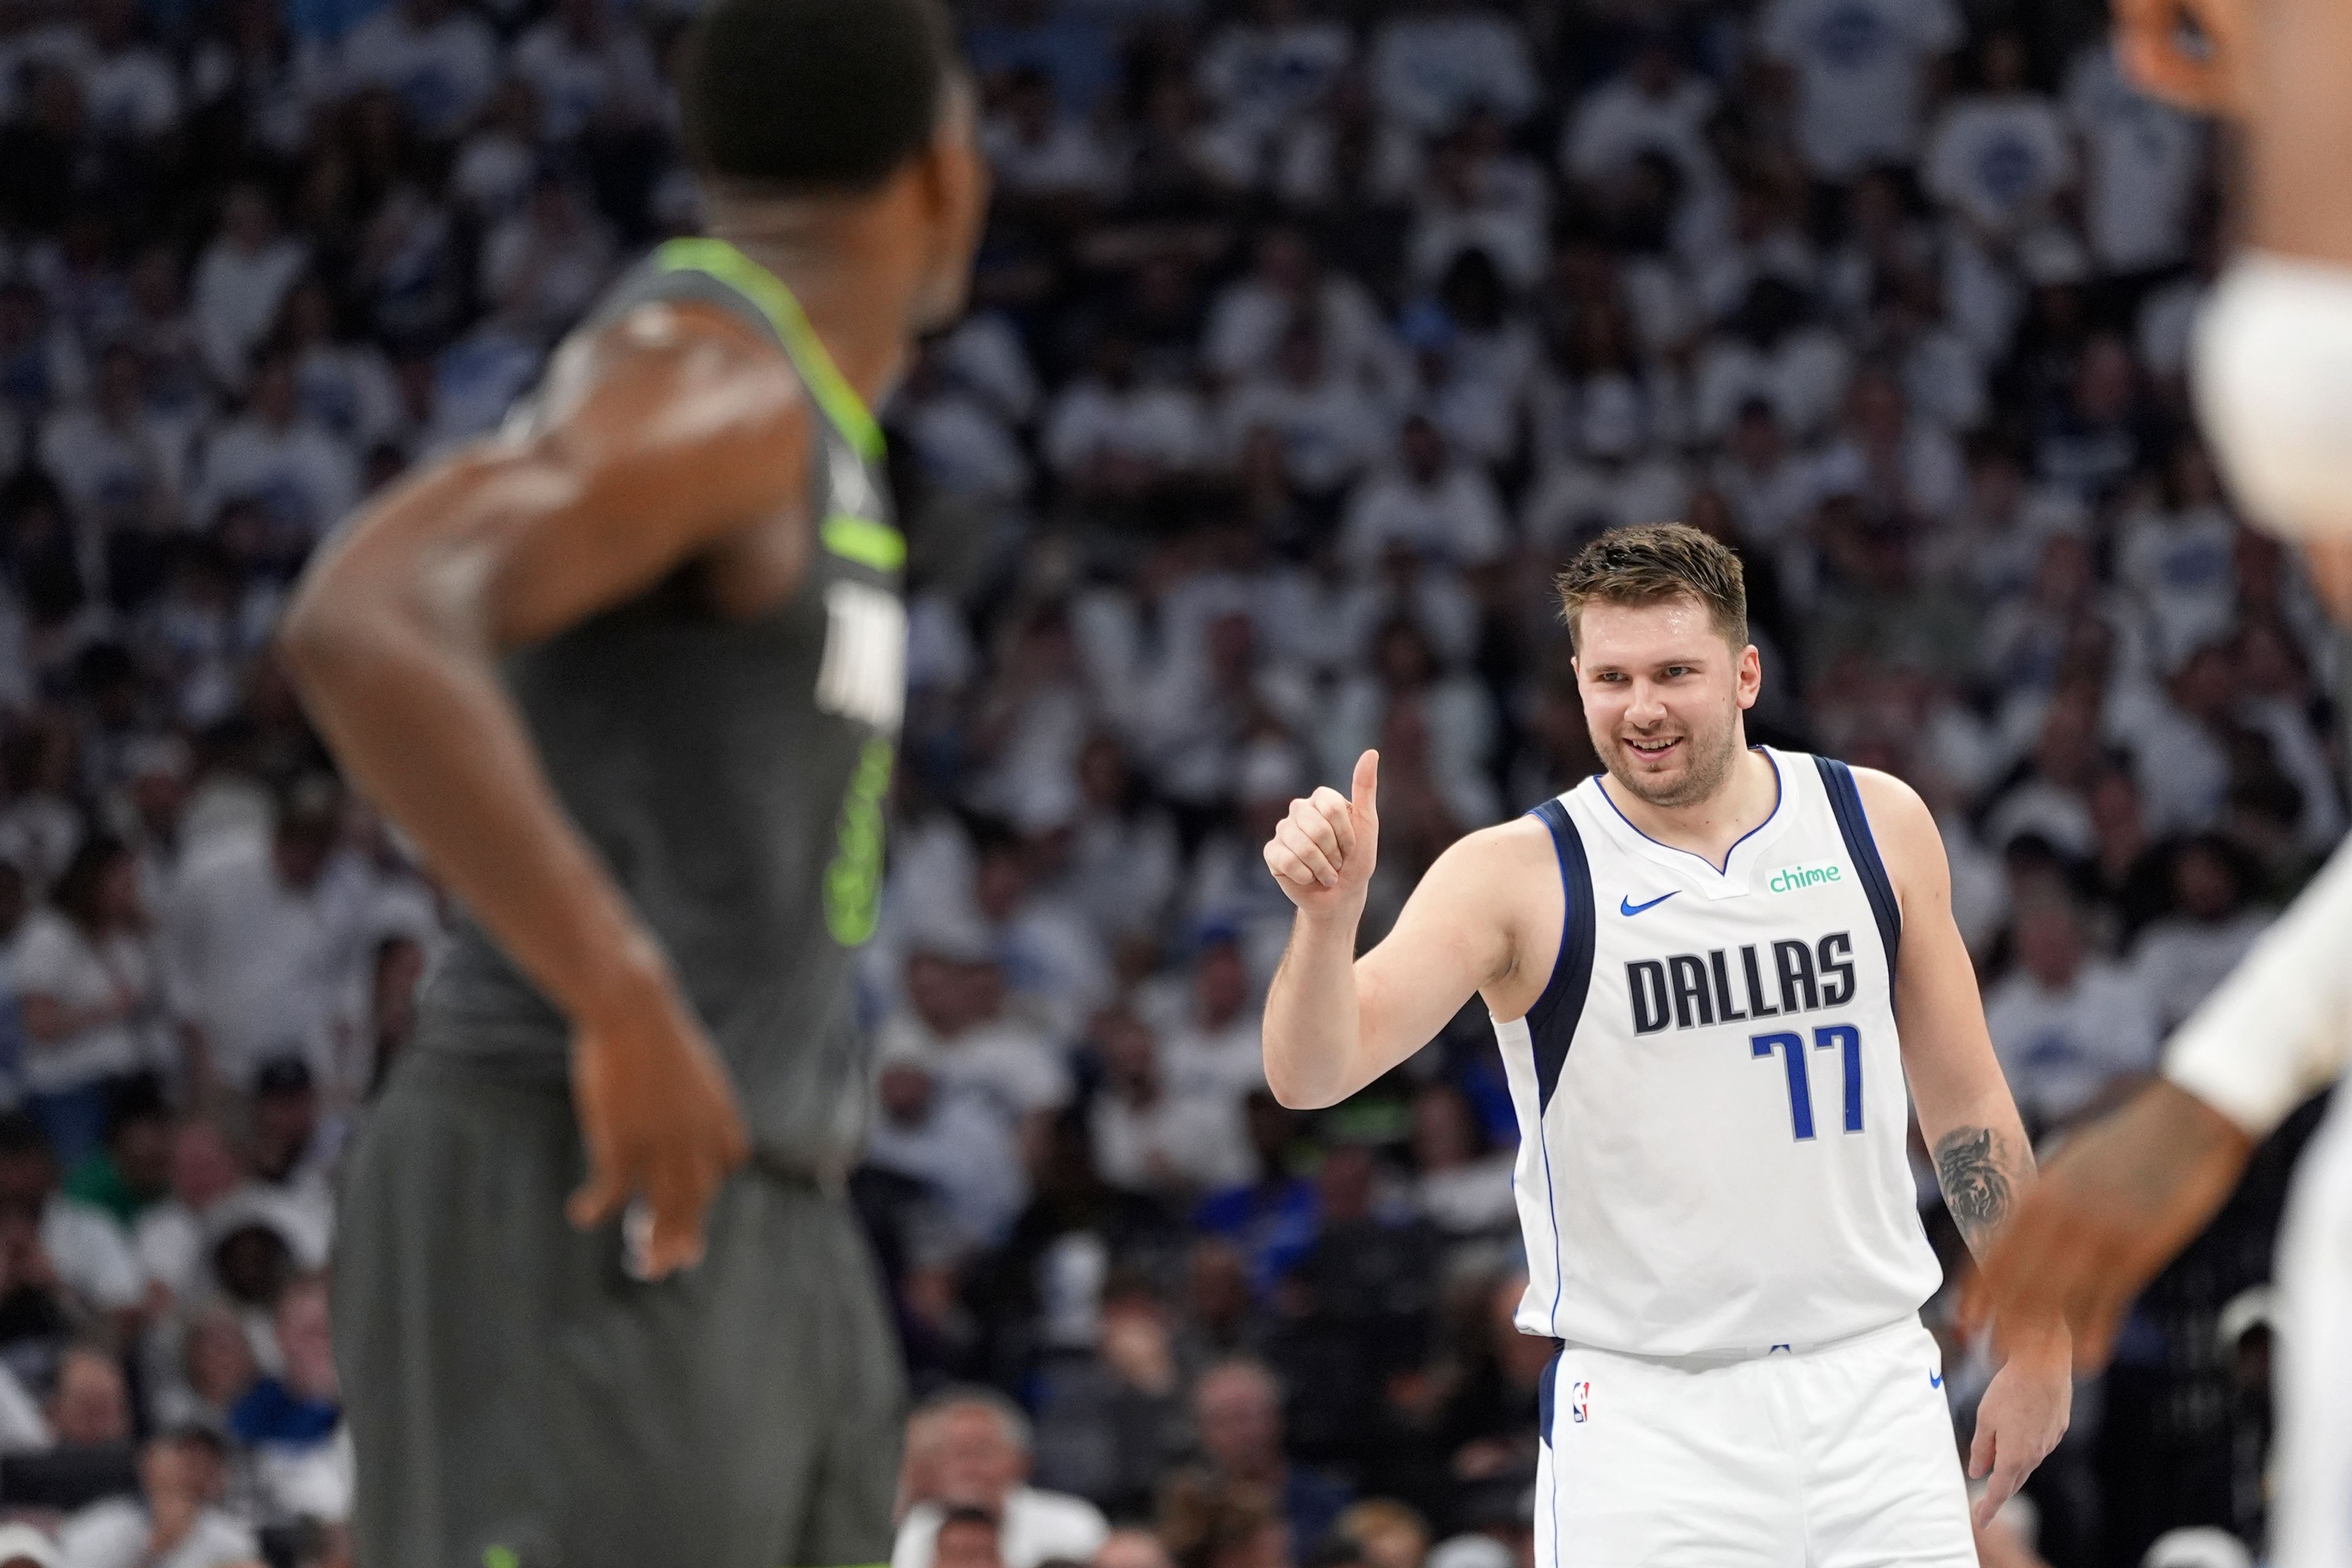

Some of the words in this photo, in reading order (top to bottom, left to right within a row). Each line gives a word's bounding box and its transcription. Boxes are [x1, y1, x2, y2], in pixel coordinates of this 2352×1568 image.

[1770, 864, 1841, 893] chime
[1624, 930, 1856, 1037] DALLAS
[1749, 1023, 1864, 1142] 77
